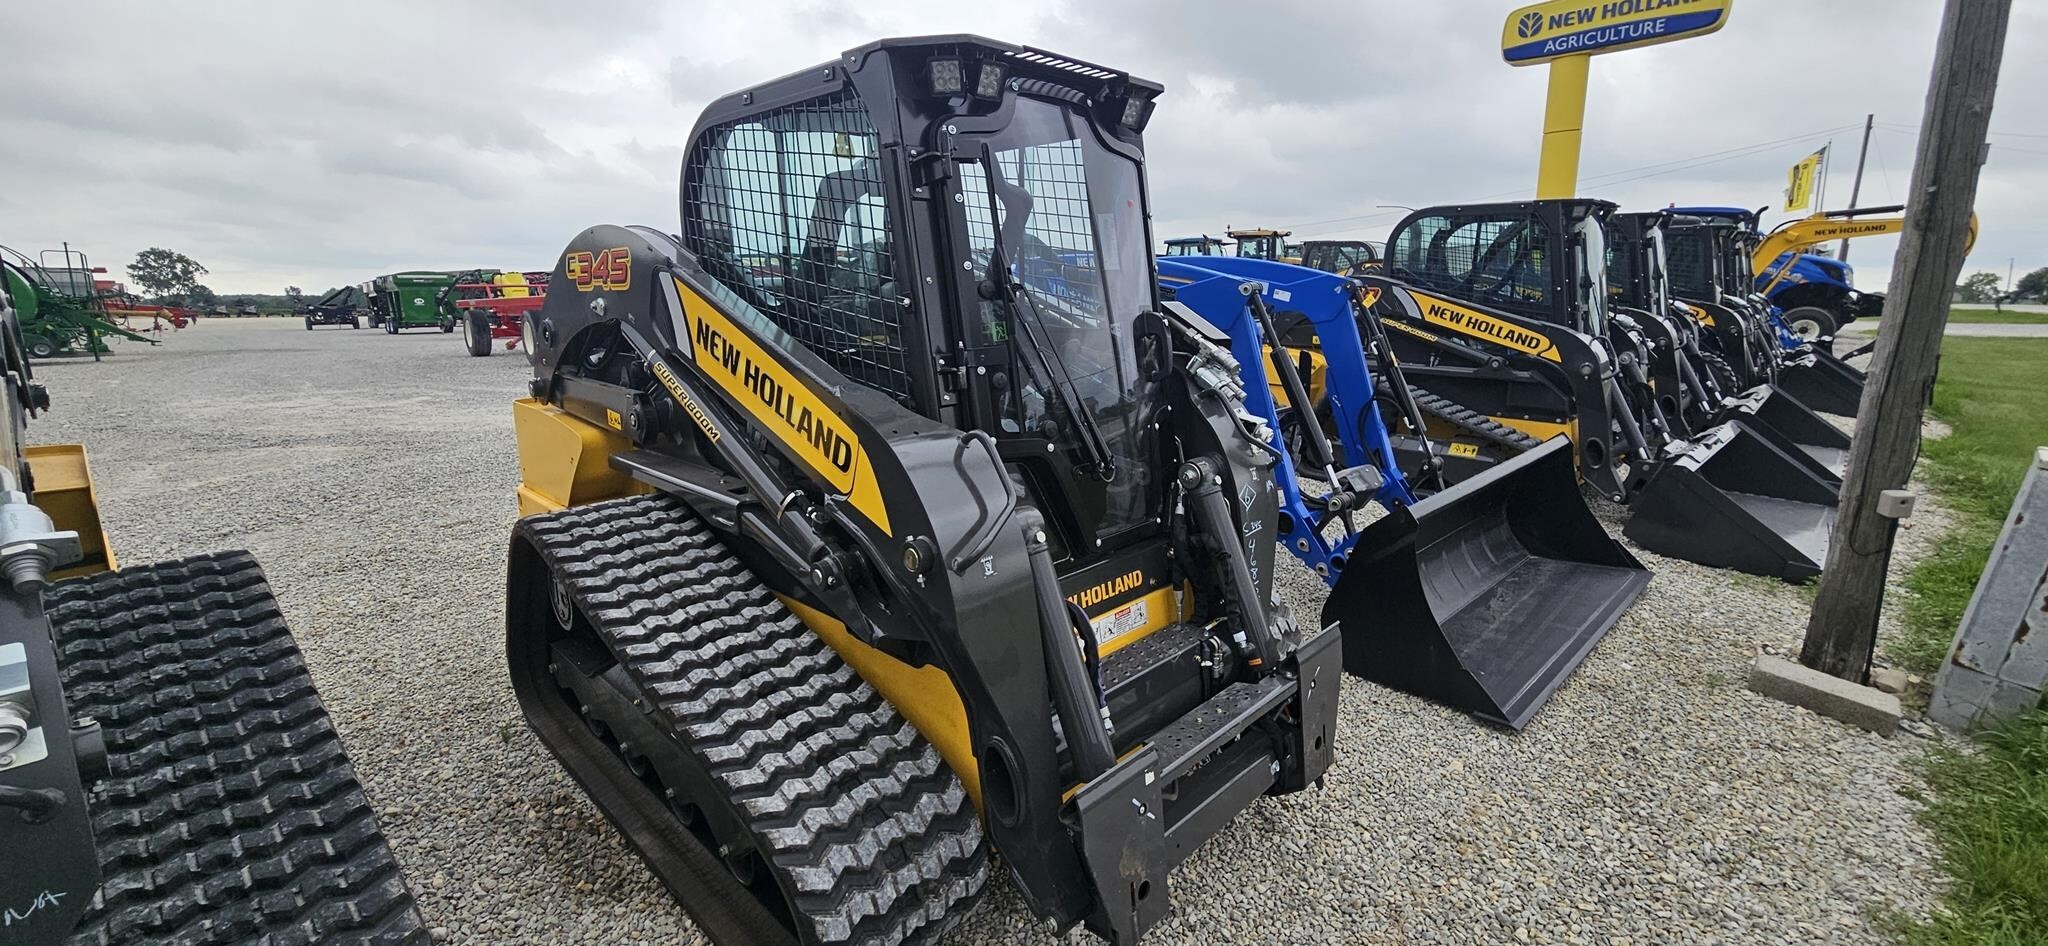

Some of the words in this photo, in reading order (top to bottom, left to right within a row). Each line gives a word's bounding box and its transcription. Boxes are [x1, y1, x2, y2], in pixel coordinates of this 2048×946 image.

[1543, 18, 1667, 53] AGRICULTURE
[1548, 6, 1597, 30] NEW
[1814, 228, 1838, 237] NEW
[1839, 224, 1887, 234] HOLLAND
[1428, 304, 1465, 324] NEW
[1465, 318, 1541, 350] HOLLAND
[696, 316, 740, 377] NEW
[743, 356, 852, 474] HOLLAND
[1080, 569, 1143, 609] HOLLAND
